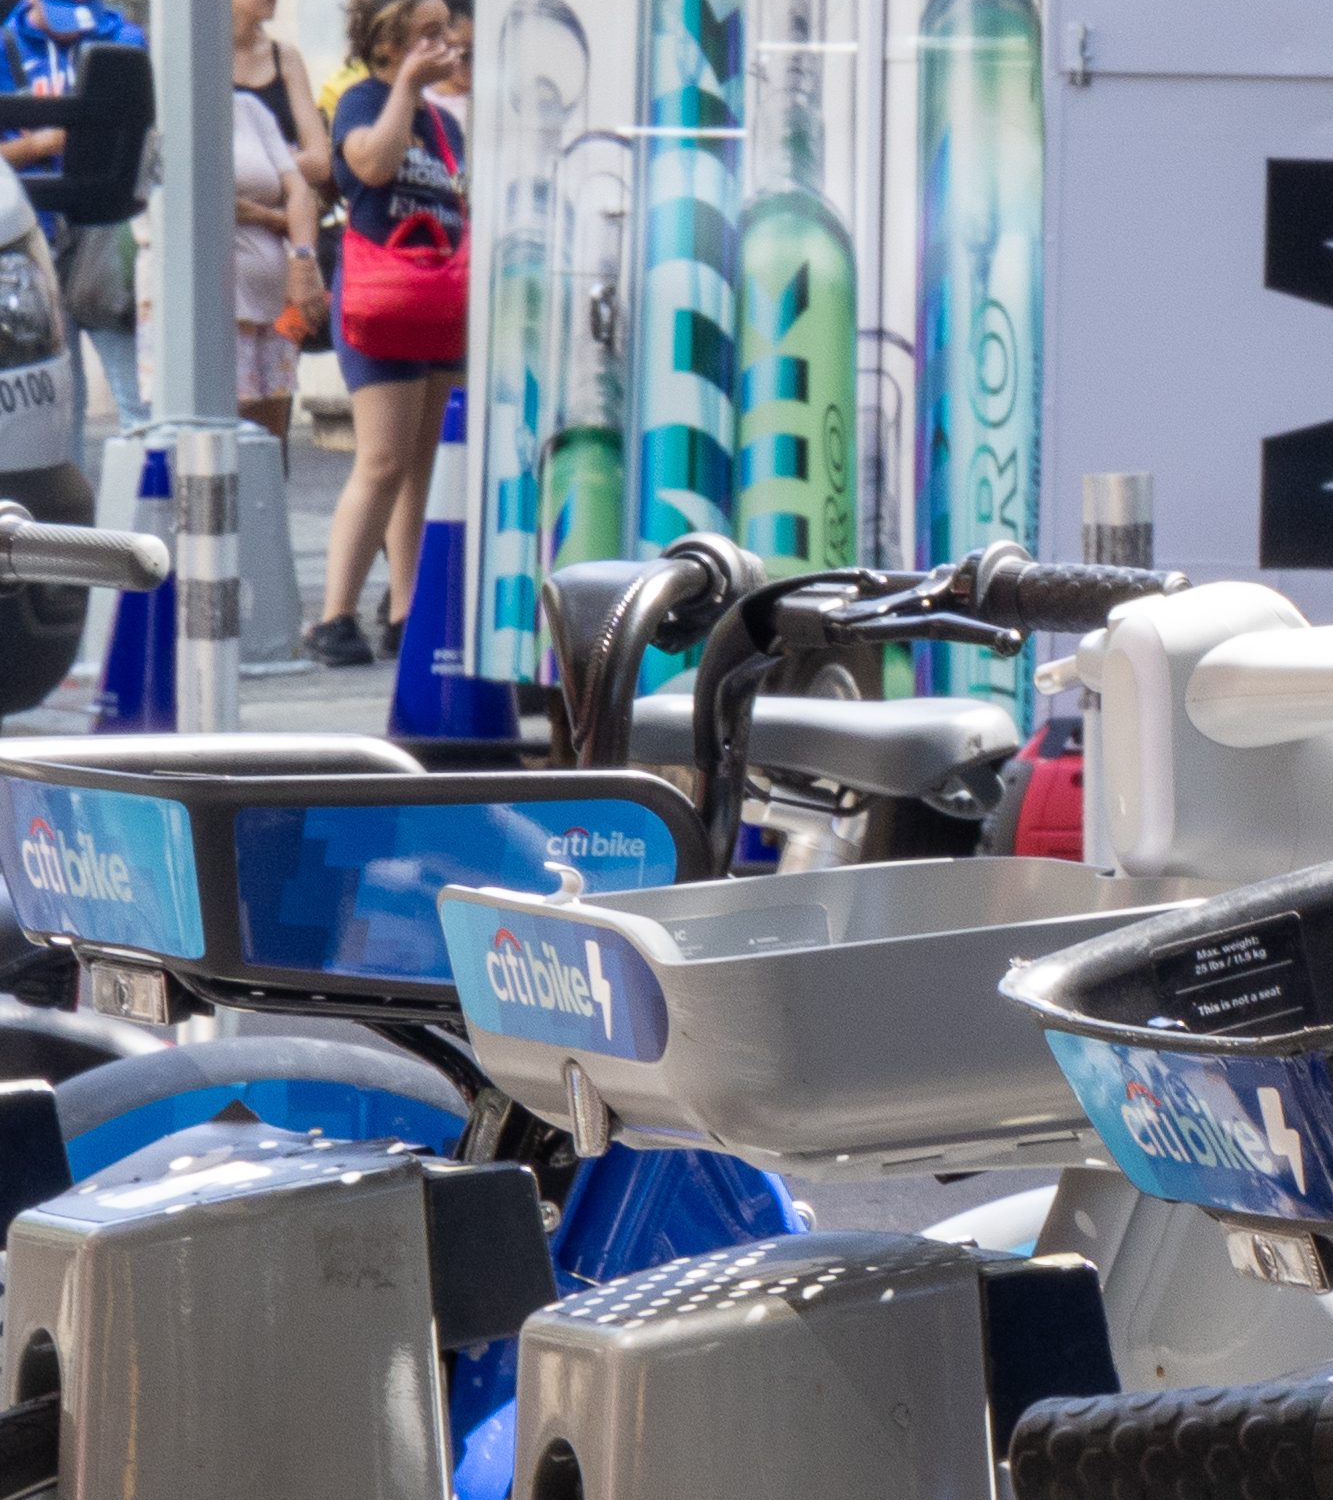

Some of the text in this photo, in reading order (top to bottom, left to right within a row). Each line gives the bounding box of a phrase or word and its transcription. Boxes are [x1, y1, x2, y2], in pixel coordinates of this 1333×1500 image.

[21, 817, 133, 903] citi bike
[545, 827, 647, 858] citi bike
[487, 928, 595, 1018] citi bike
[1252, 948, 1267, 960] kg
[1198, 1003, 1221, 1017] This
[1232, 994, 1250, 1008] not
[1250, 993, 1258, 1002] a
[1258, 985, 1282, 1000] seat
[1121, 1081, 1277, 1174] citi bike
